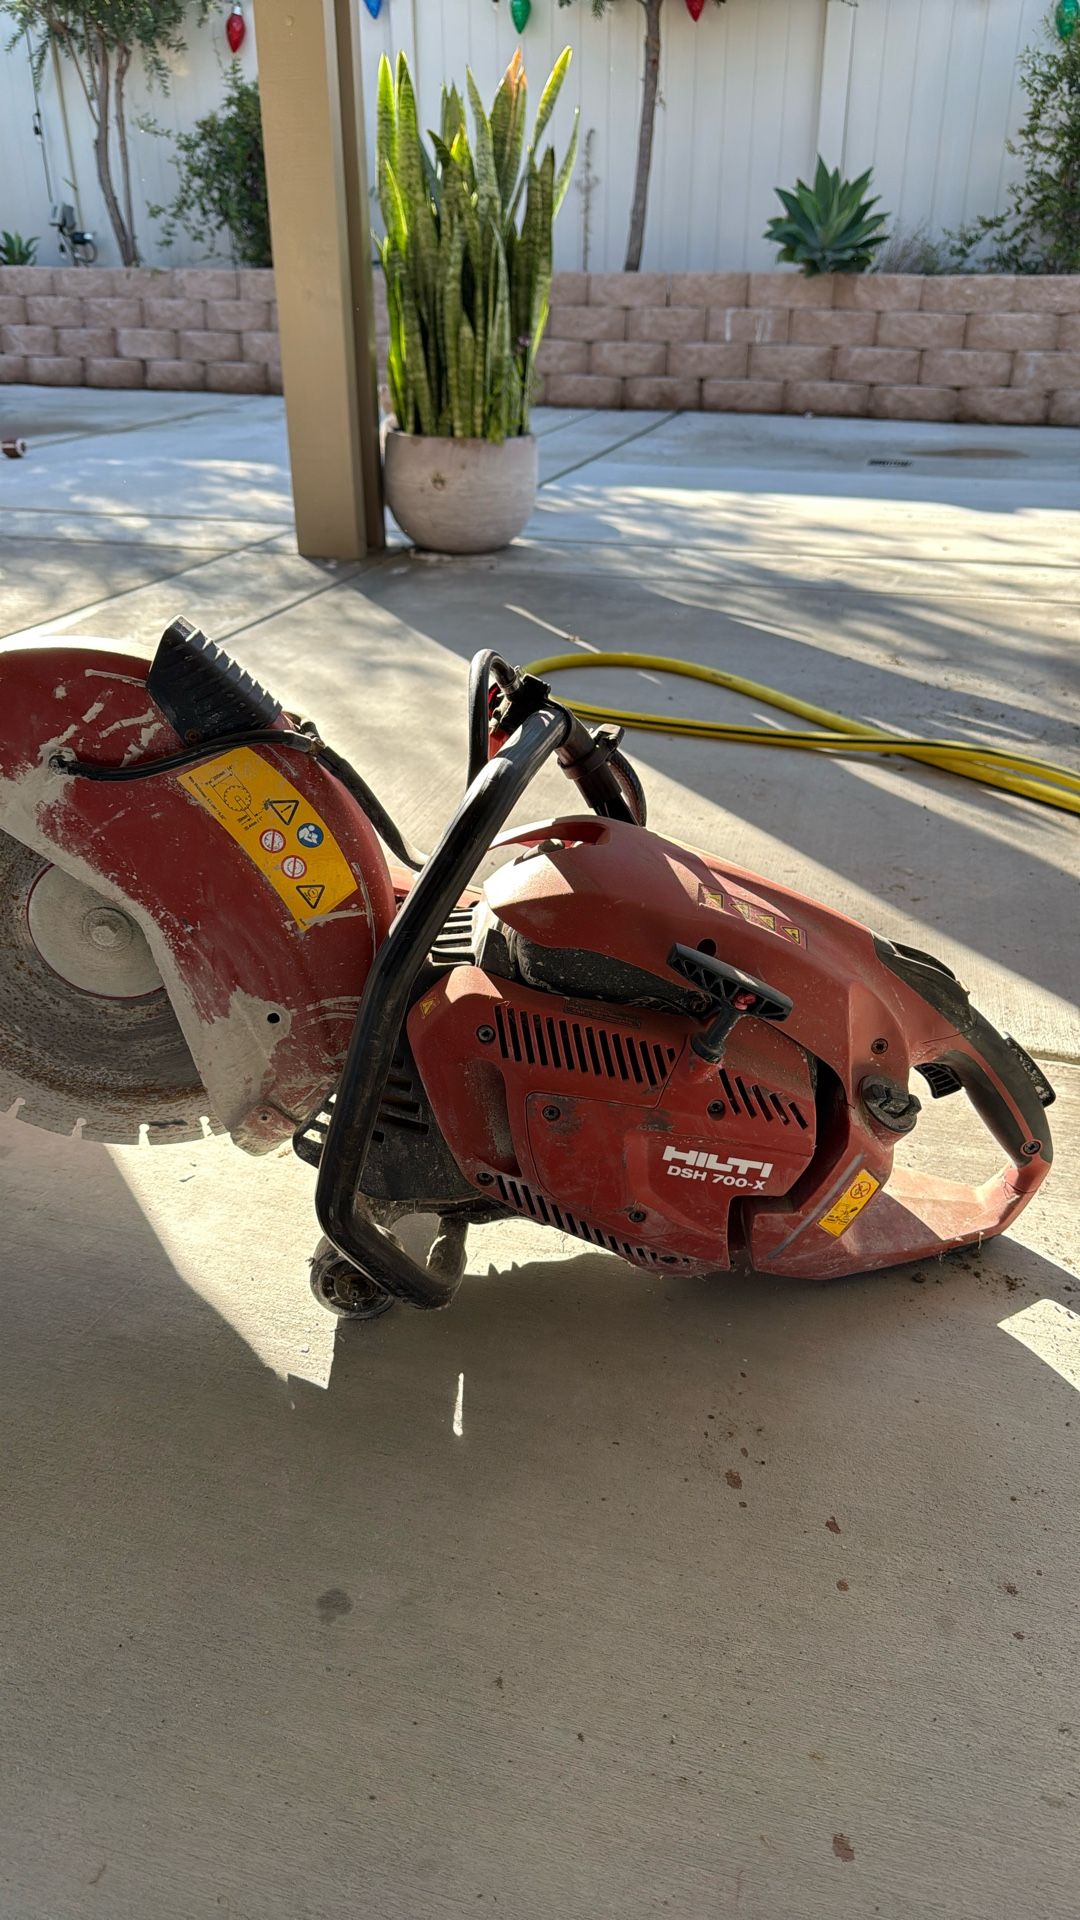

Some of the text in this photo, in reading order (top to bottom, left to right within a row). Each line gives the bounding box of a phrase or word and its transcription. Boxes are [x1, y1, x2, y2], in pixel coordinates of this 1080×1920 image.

[662, 1145, 774, 1178] HILTI
[667, 1165, 766, 1190] DSH 700-X
